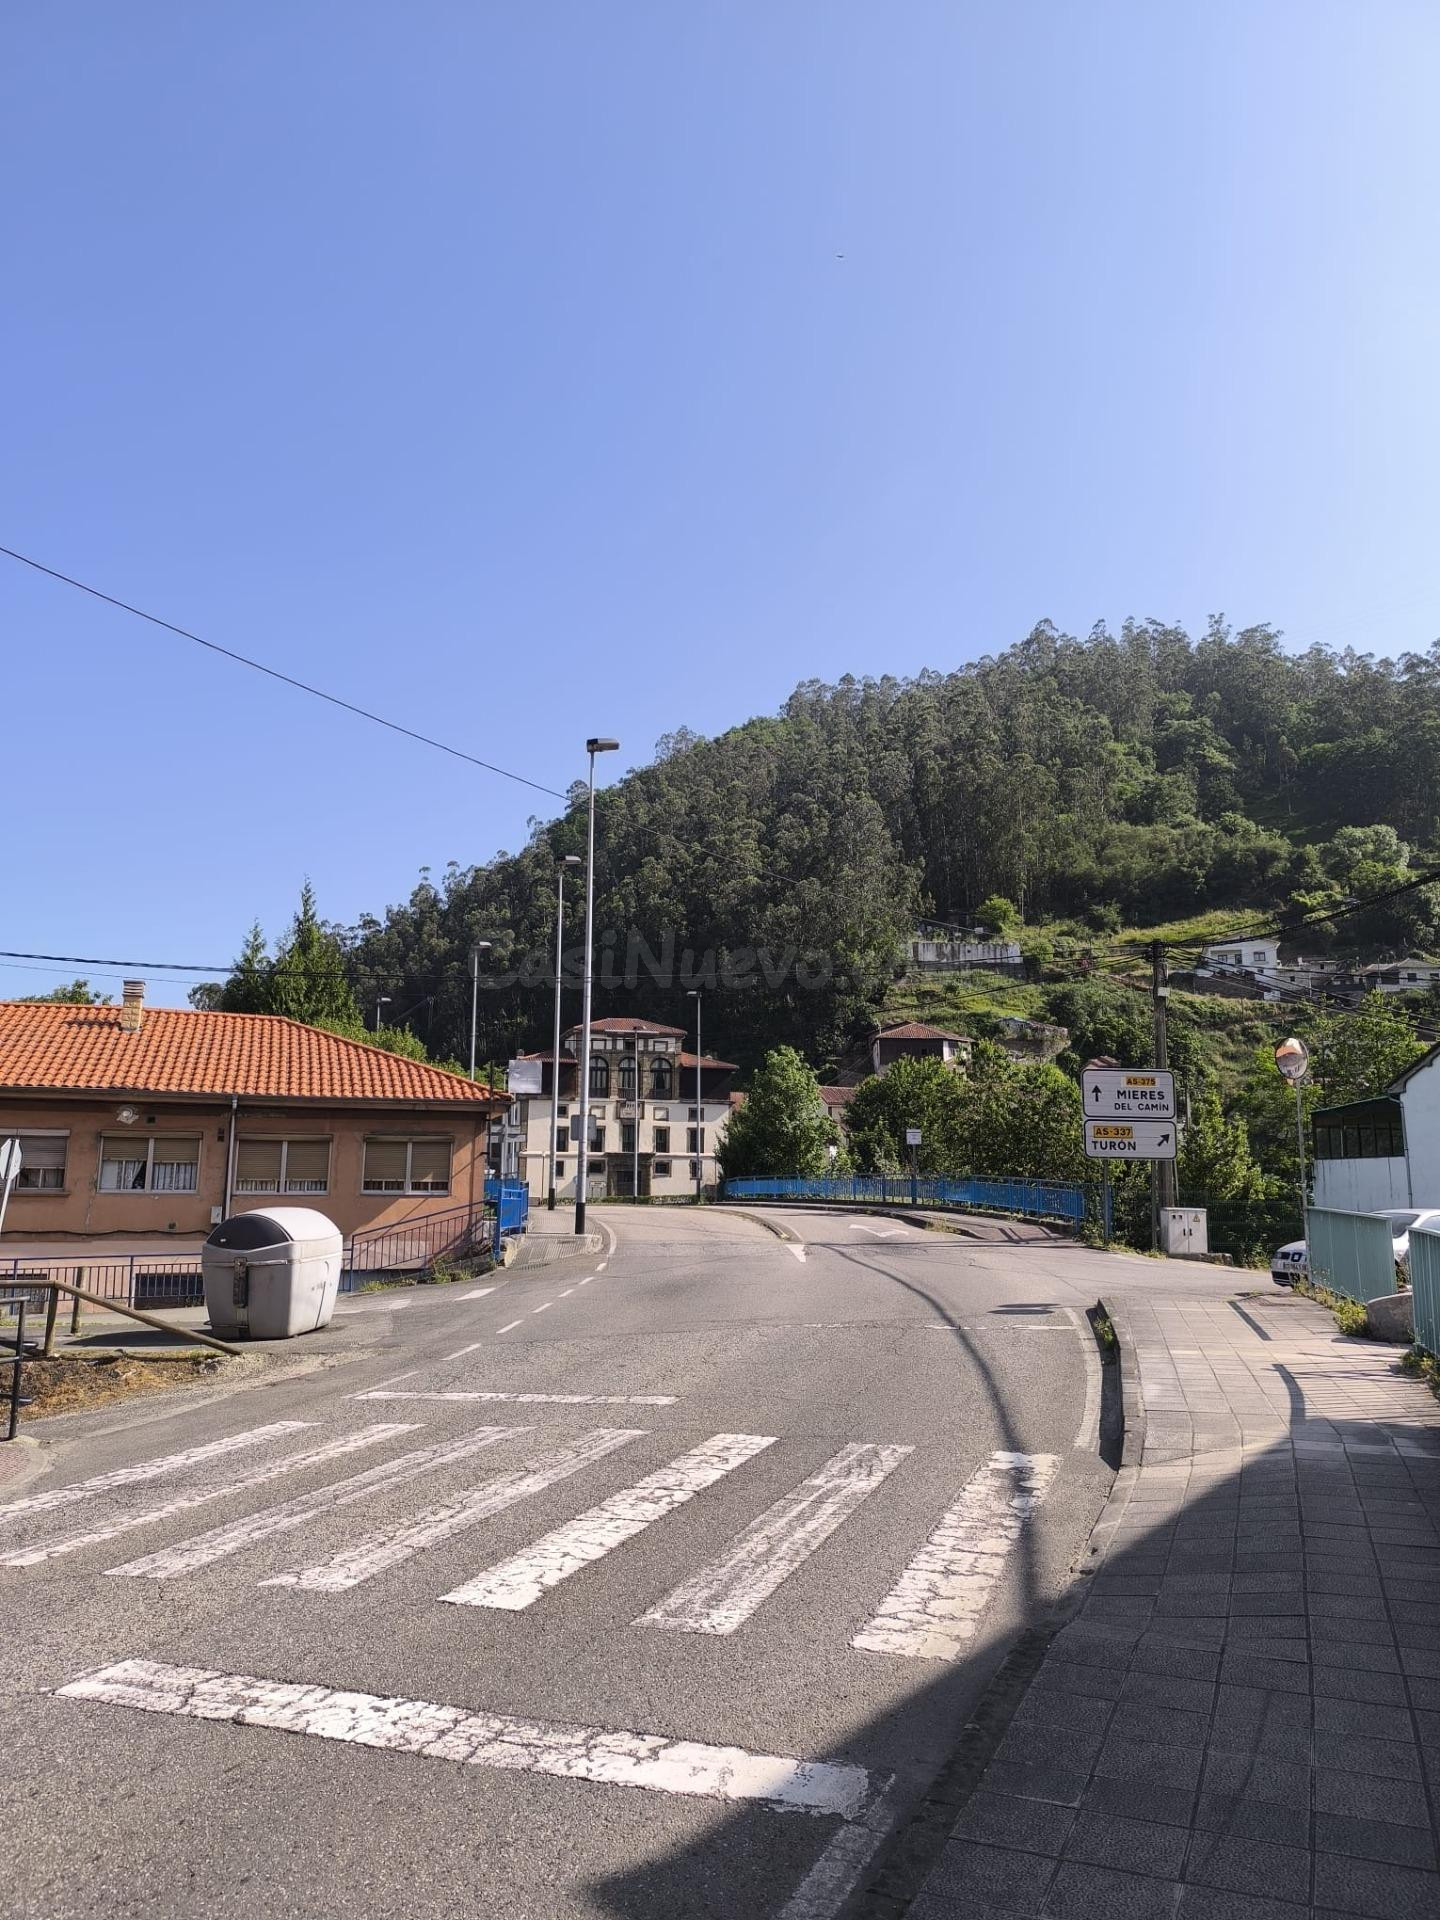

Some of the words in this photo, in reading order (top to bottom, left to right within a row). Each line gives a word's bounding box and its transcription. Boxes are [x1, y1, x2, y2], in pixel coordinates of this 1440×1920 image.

[1126, 1077, 1156, 1086] AS-375
[1116, 1090, 1165, 1100] MIERES
[1114, 1103, 1132, 1111] DEL
[1095, 1127, 1131, 1136] AS-337
[1092, 1139, 1136, 1151] TURÓN
